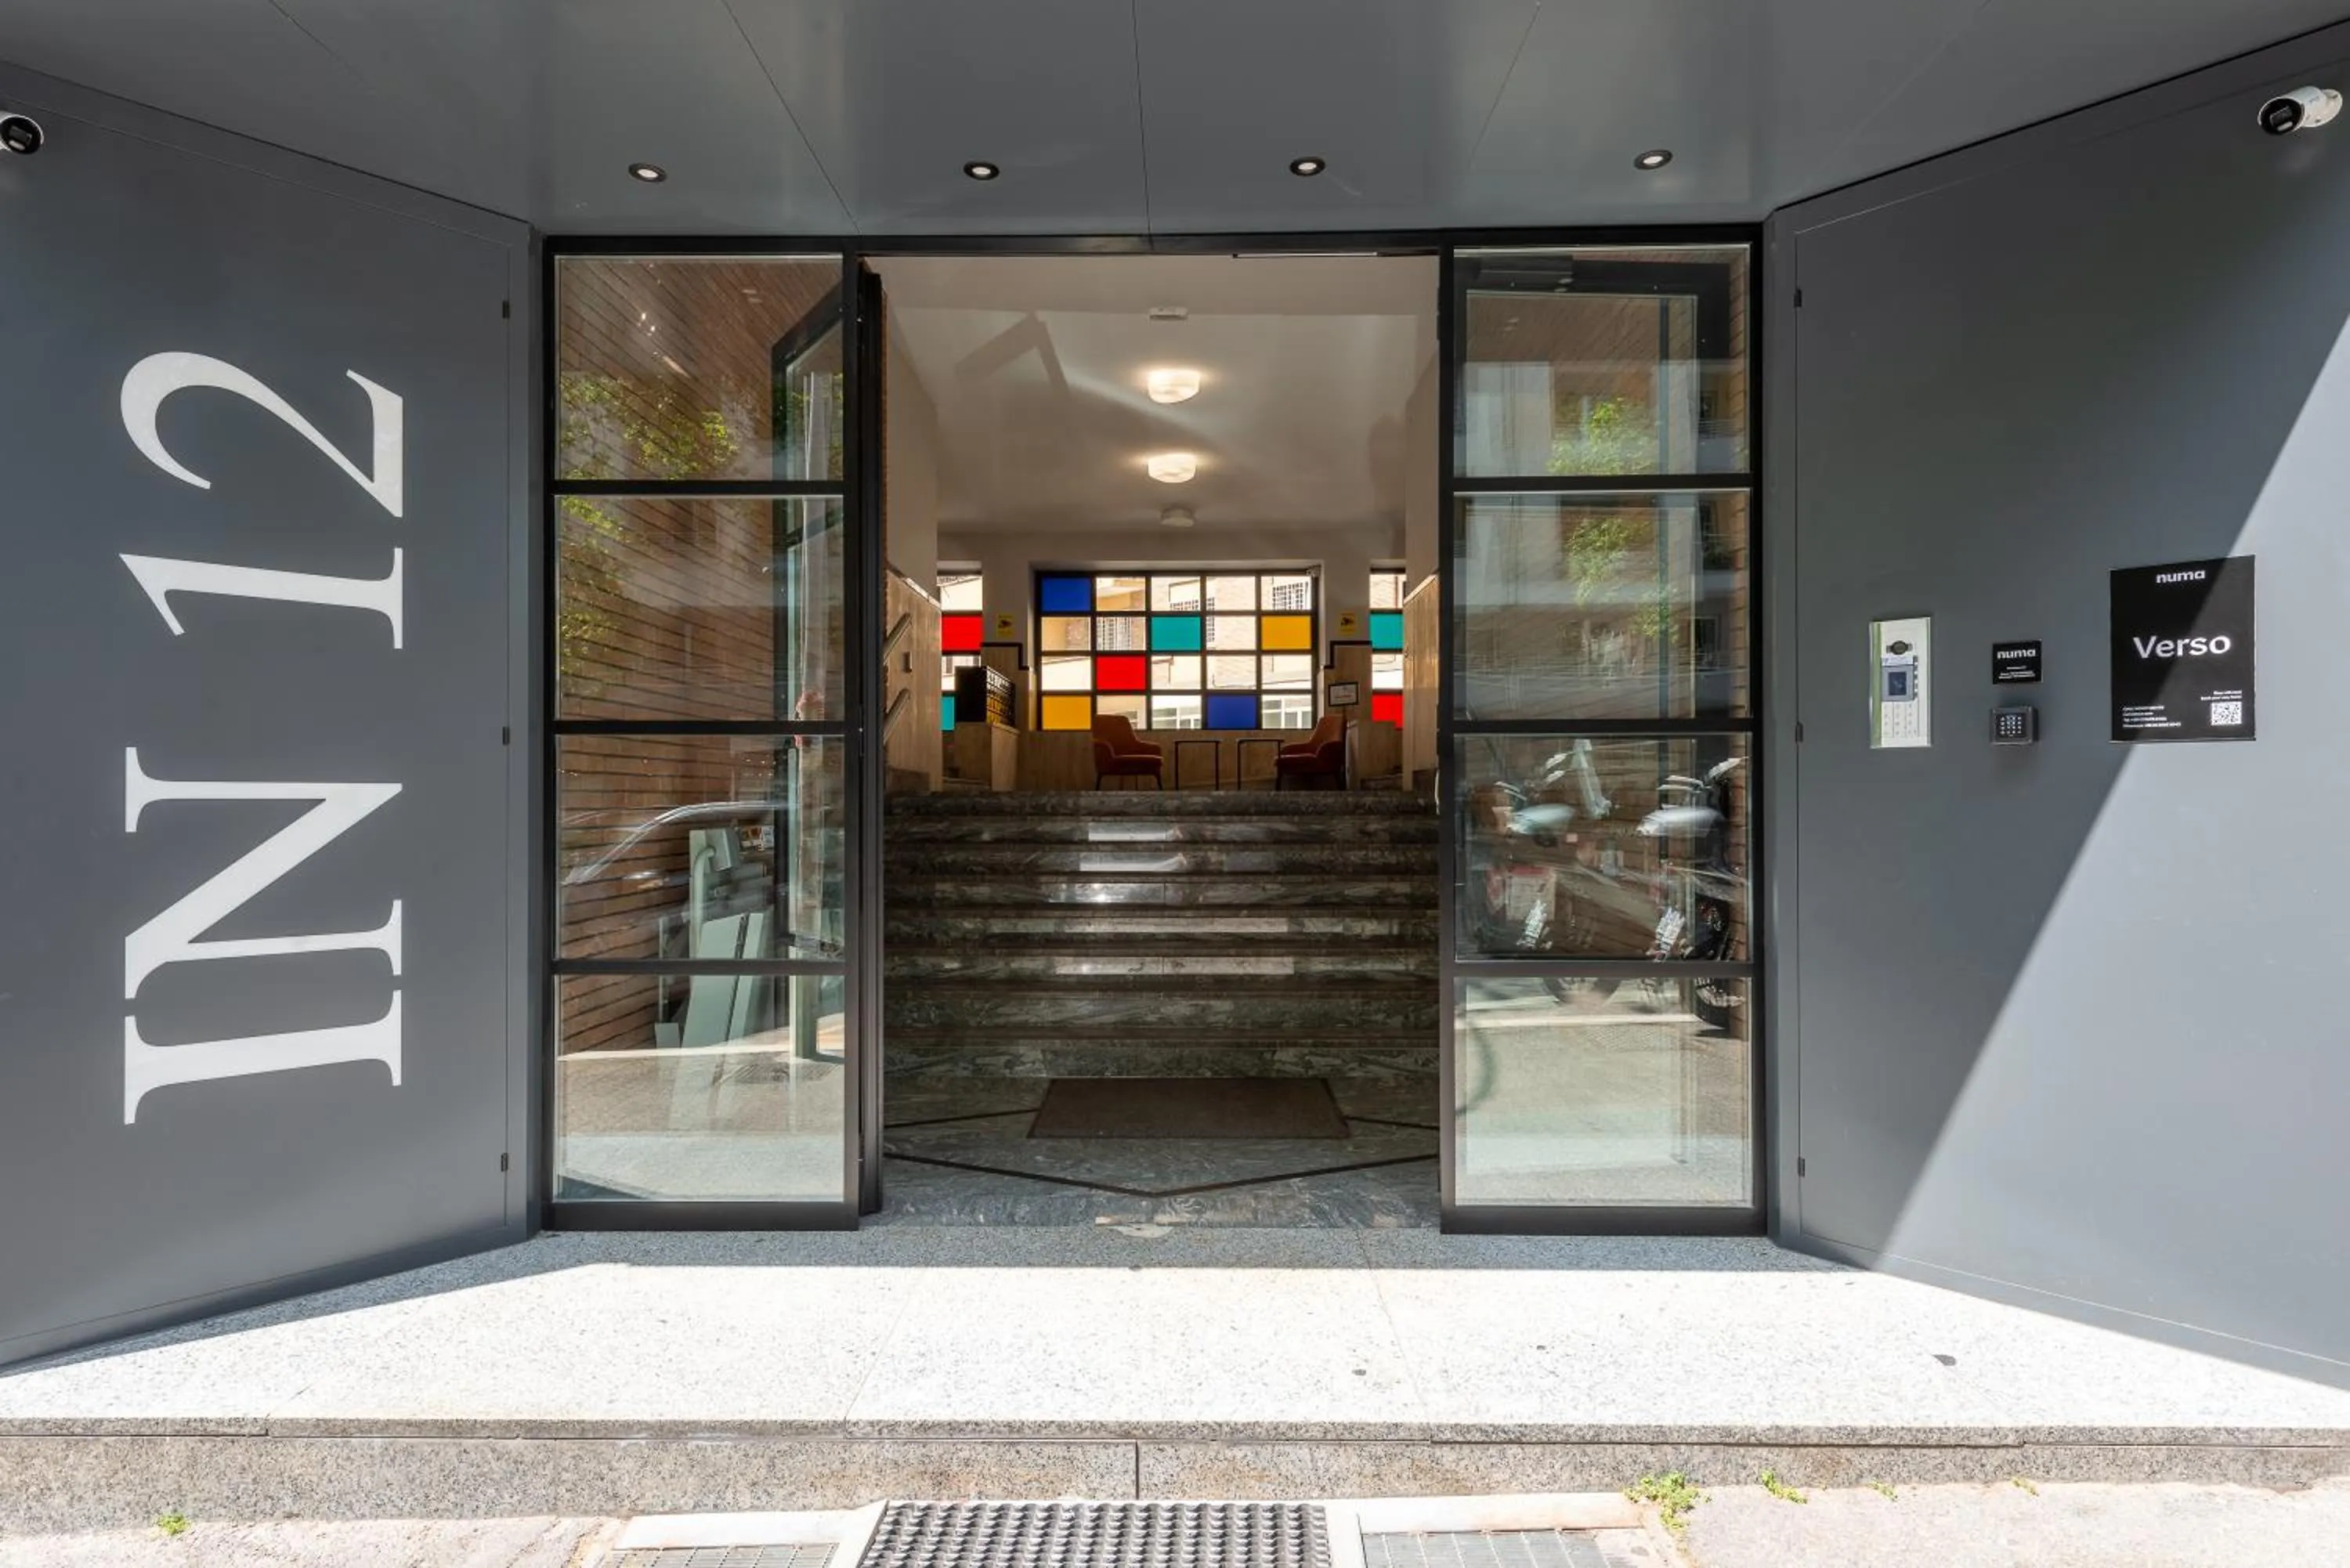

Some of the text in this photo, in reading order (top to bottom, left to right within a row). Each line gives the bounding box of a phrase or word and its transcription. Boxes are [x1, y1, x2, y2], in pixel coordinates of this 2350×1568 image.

[2156, 569, 2206, 583] numa
[1997, 649, 2036, 659] numa
[2132, 634, 2232, 659] Verso
[119, 351, 403, 1125] IN 12
